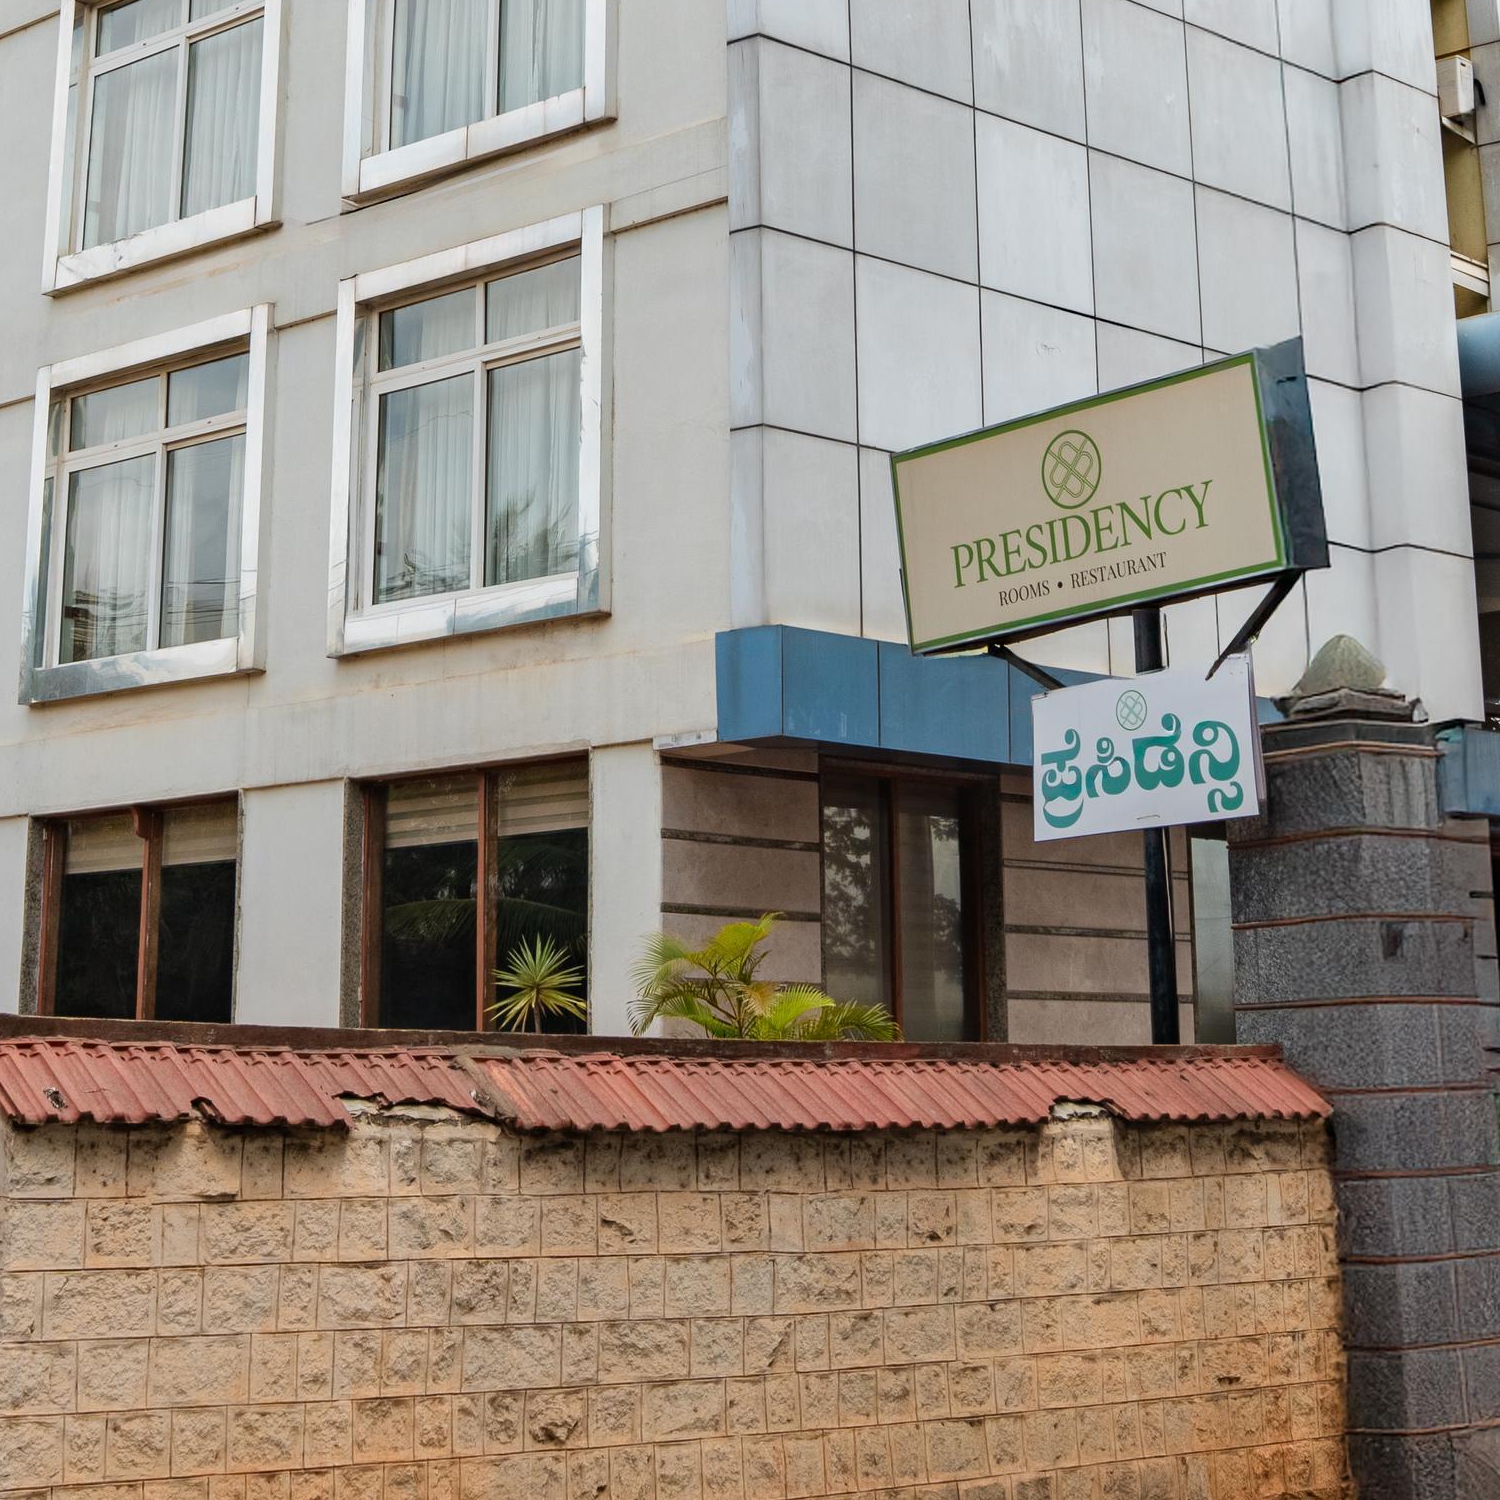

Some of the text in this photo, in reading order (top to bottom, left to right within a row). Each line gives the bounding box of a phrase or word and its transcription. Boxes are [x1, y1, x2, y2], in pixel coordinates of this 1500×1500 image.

[951, 479, 1213, 589] PRESIDENCY
[999, 551, 1167, 607] ROOMS RESTAURANT
[1041, 713, 1244, 829] ಪ್ರೆಸಿಡೆನ್ಸಿ
